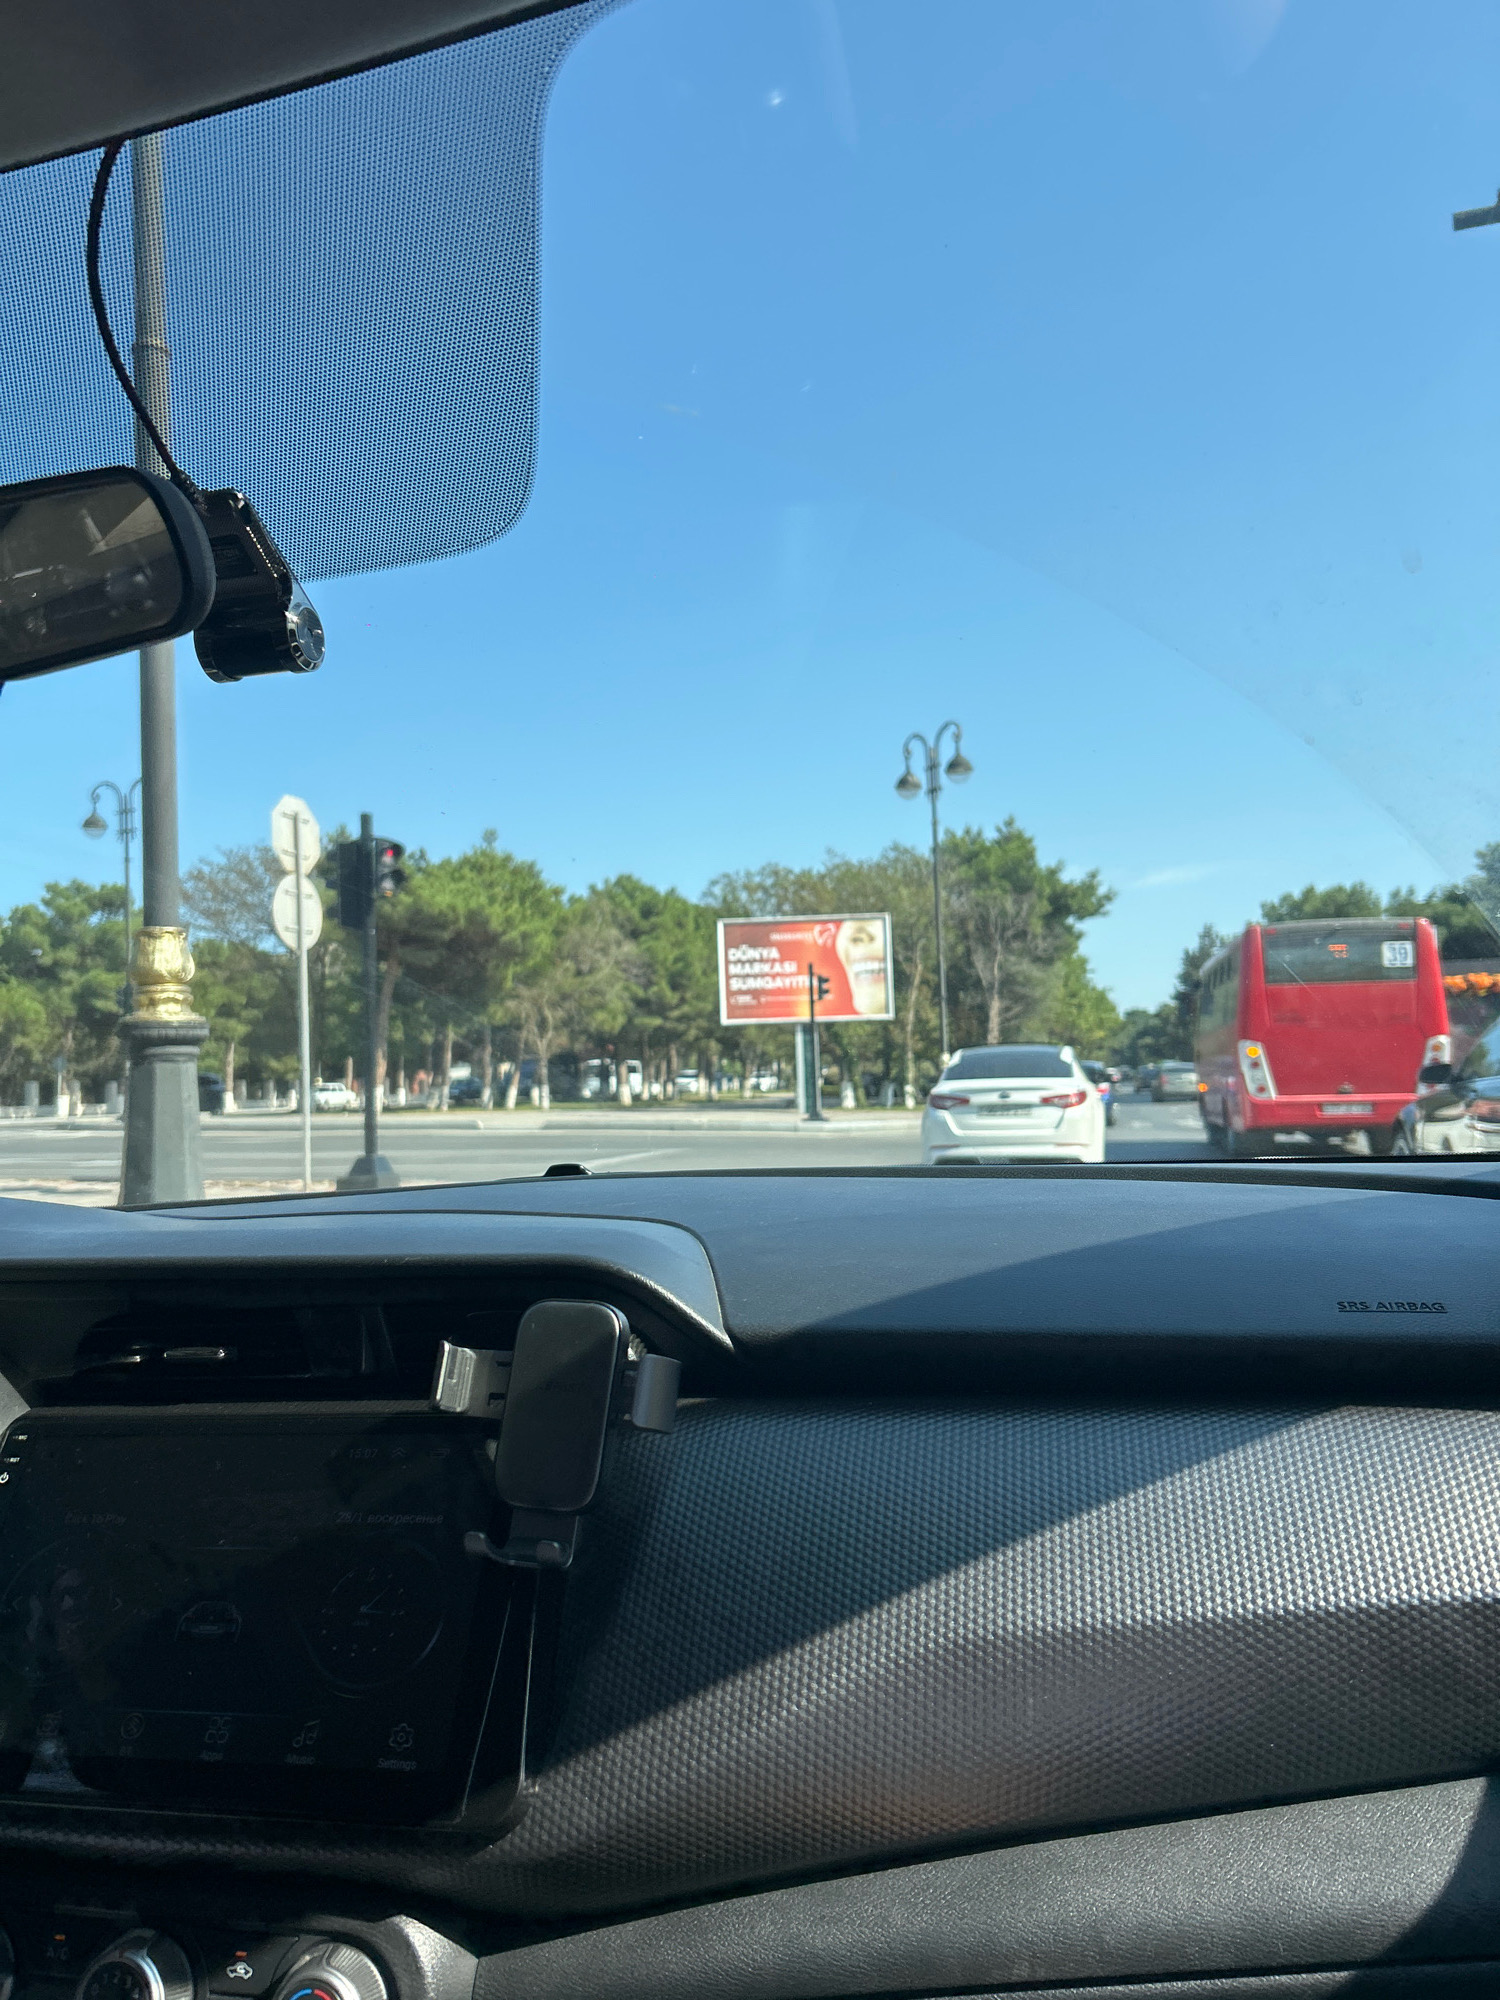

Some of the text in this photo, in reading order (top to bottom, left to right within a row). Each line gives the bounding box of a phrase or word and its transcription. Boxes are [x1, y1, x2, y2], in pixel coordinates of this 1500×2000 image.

[1336, 1301, 1446, 1312] SRS AIRBAG
[377, 1757, 418, 1772] Settings
